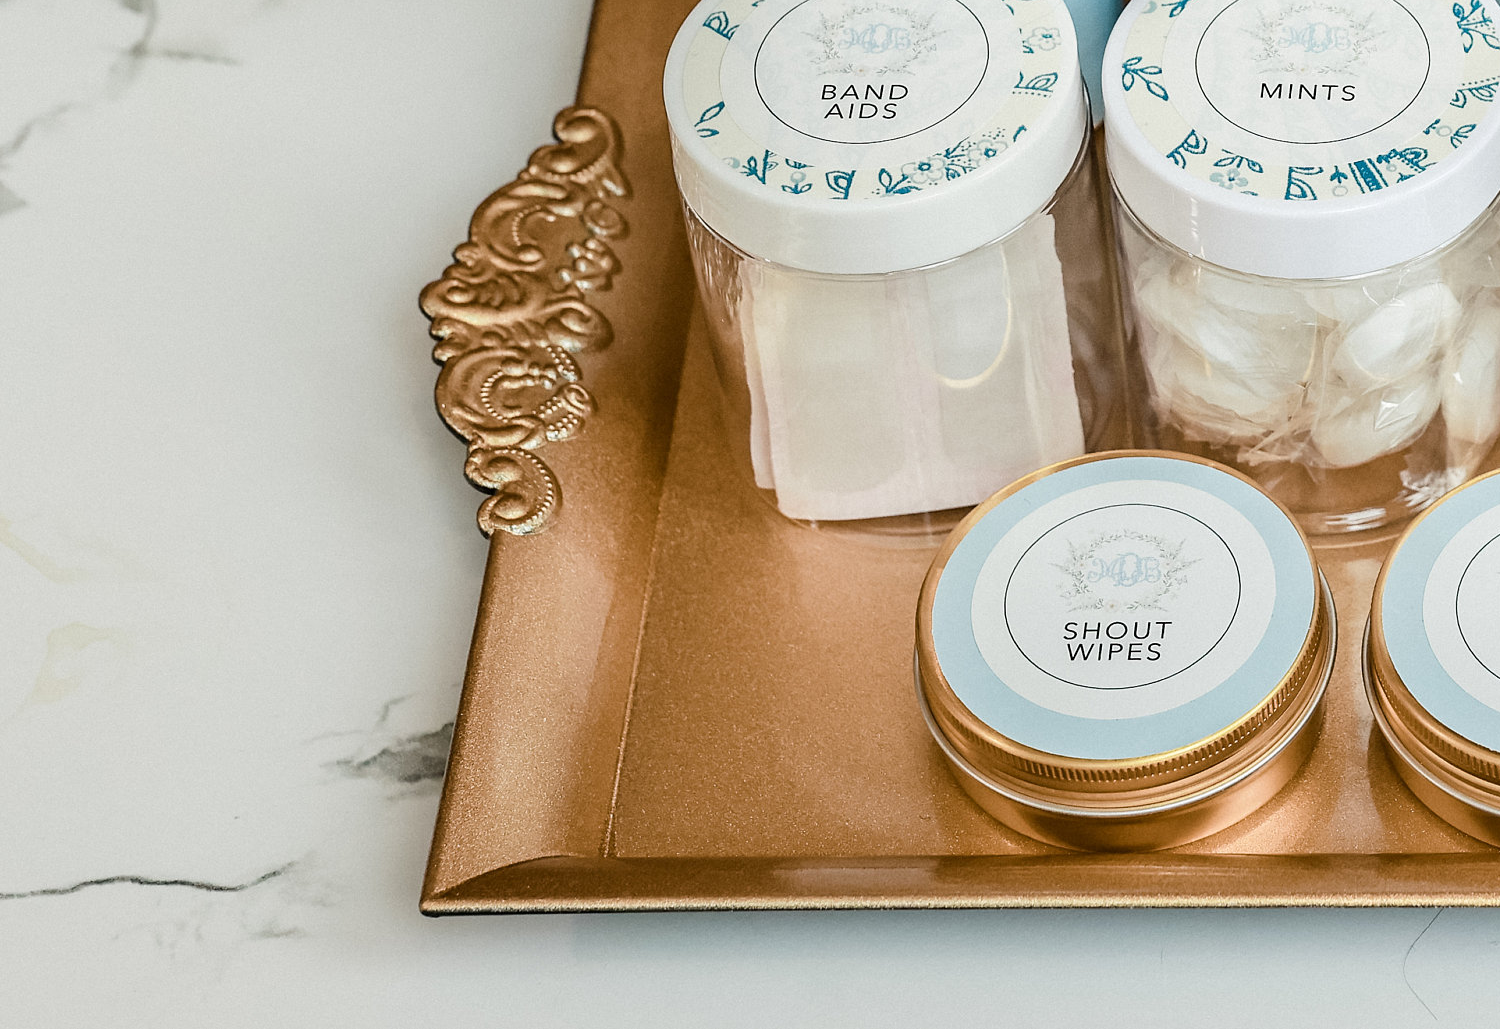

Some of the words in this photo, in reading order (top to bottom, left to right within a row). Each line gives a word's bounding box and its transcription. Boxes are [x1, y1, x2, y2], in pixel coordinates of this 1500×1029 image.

[822, 85, 908, 100] BAND
[1261, 83, 1355, 101] MINTS
[824, 103, 897, 119] AIDS
[1064, 622, 1172, 640] SHOUT
[1067, 643, 1161, 661] WIPES
